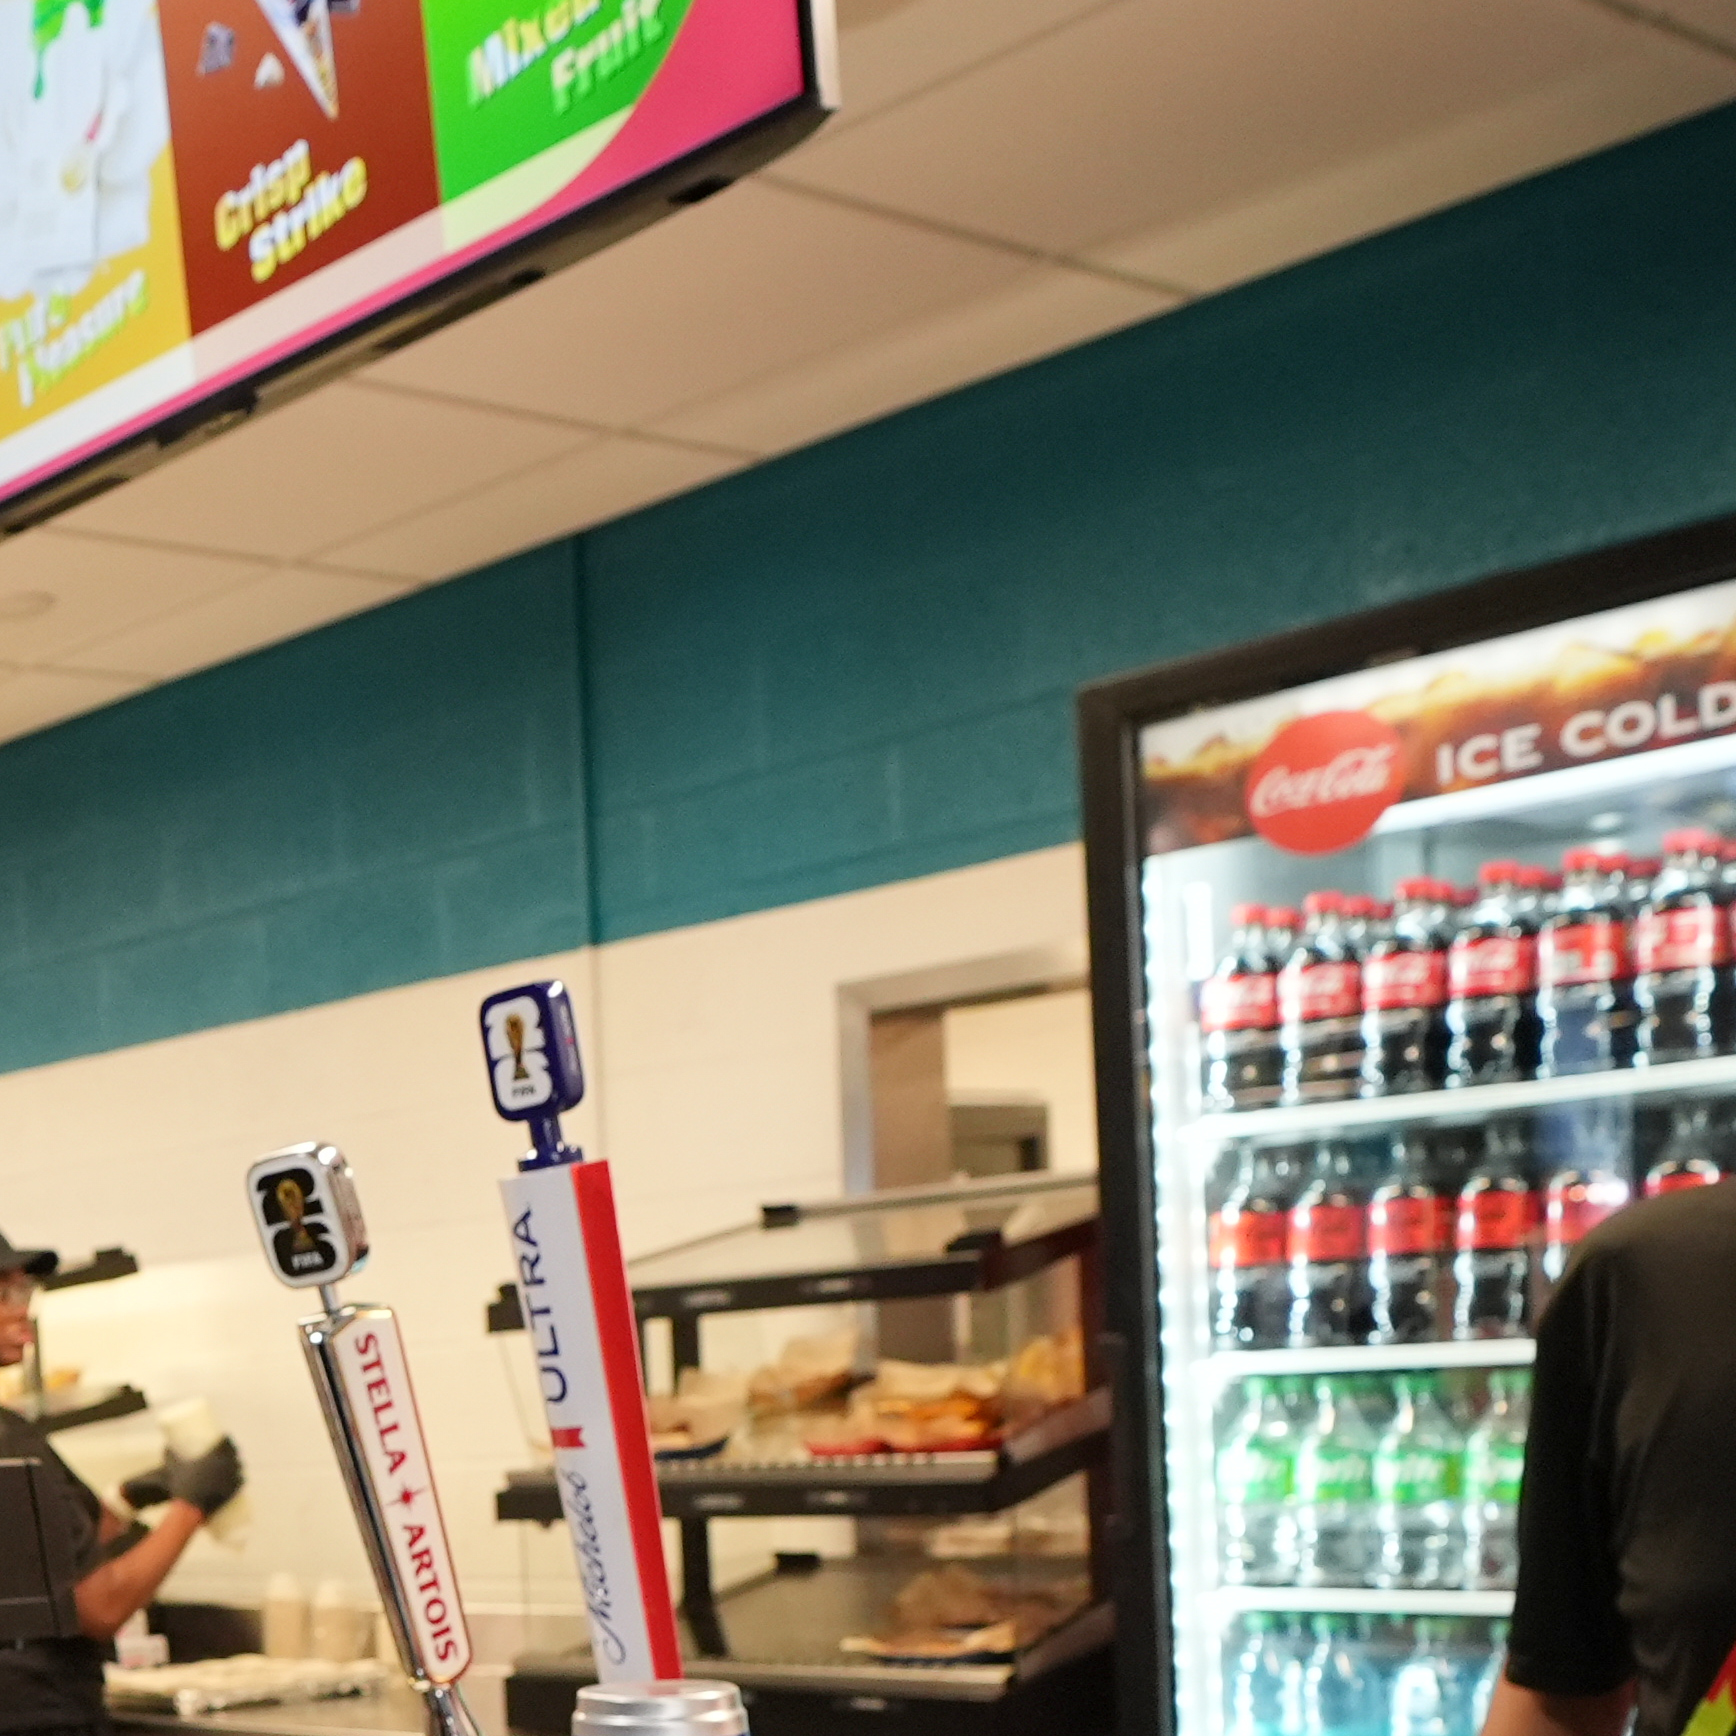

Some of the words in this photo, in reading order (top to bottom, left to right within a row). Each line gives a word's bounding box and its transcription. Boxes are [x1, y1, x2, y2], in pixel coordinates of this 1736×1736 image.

[550, 0, 664, 116] Fruit
[214, 138, 312, 252] Crisp
[249, 155, 368, 283] Strike
[1436, 724, 1544, 785] ICE
[1559, 680, 1736, 758] COLD
[513, 1208, 569, 1405] ULTRA
[354, 1332, 409, 1477] STELLA
[402, 1522, 459, 1663] ARTOIS
